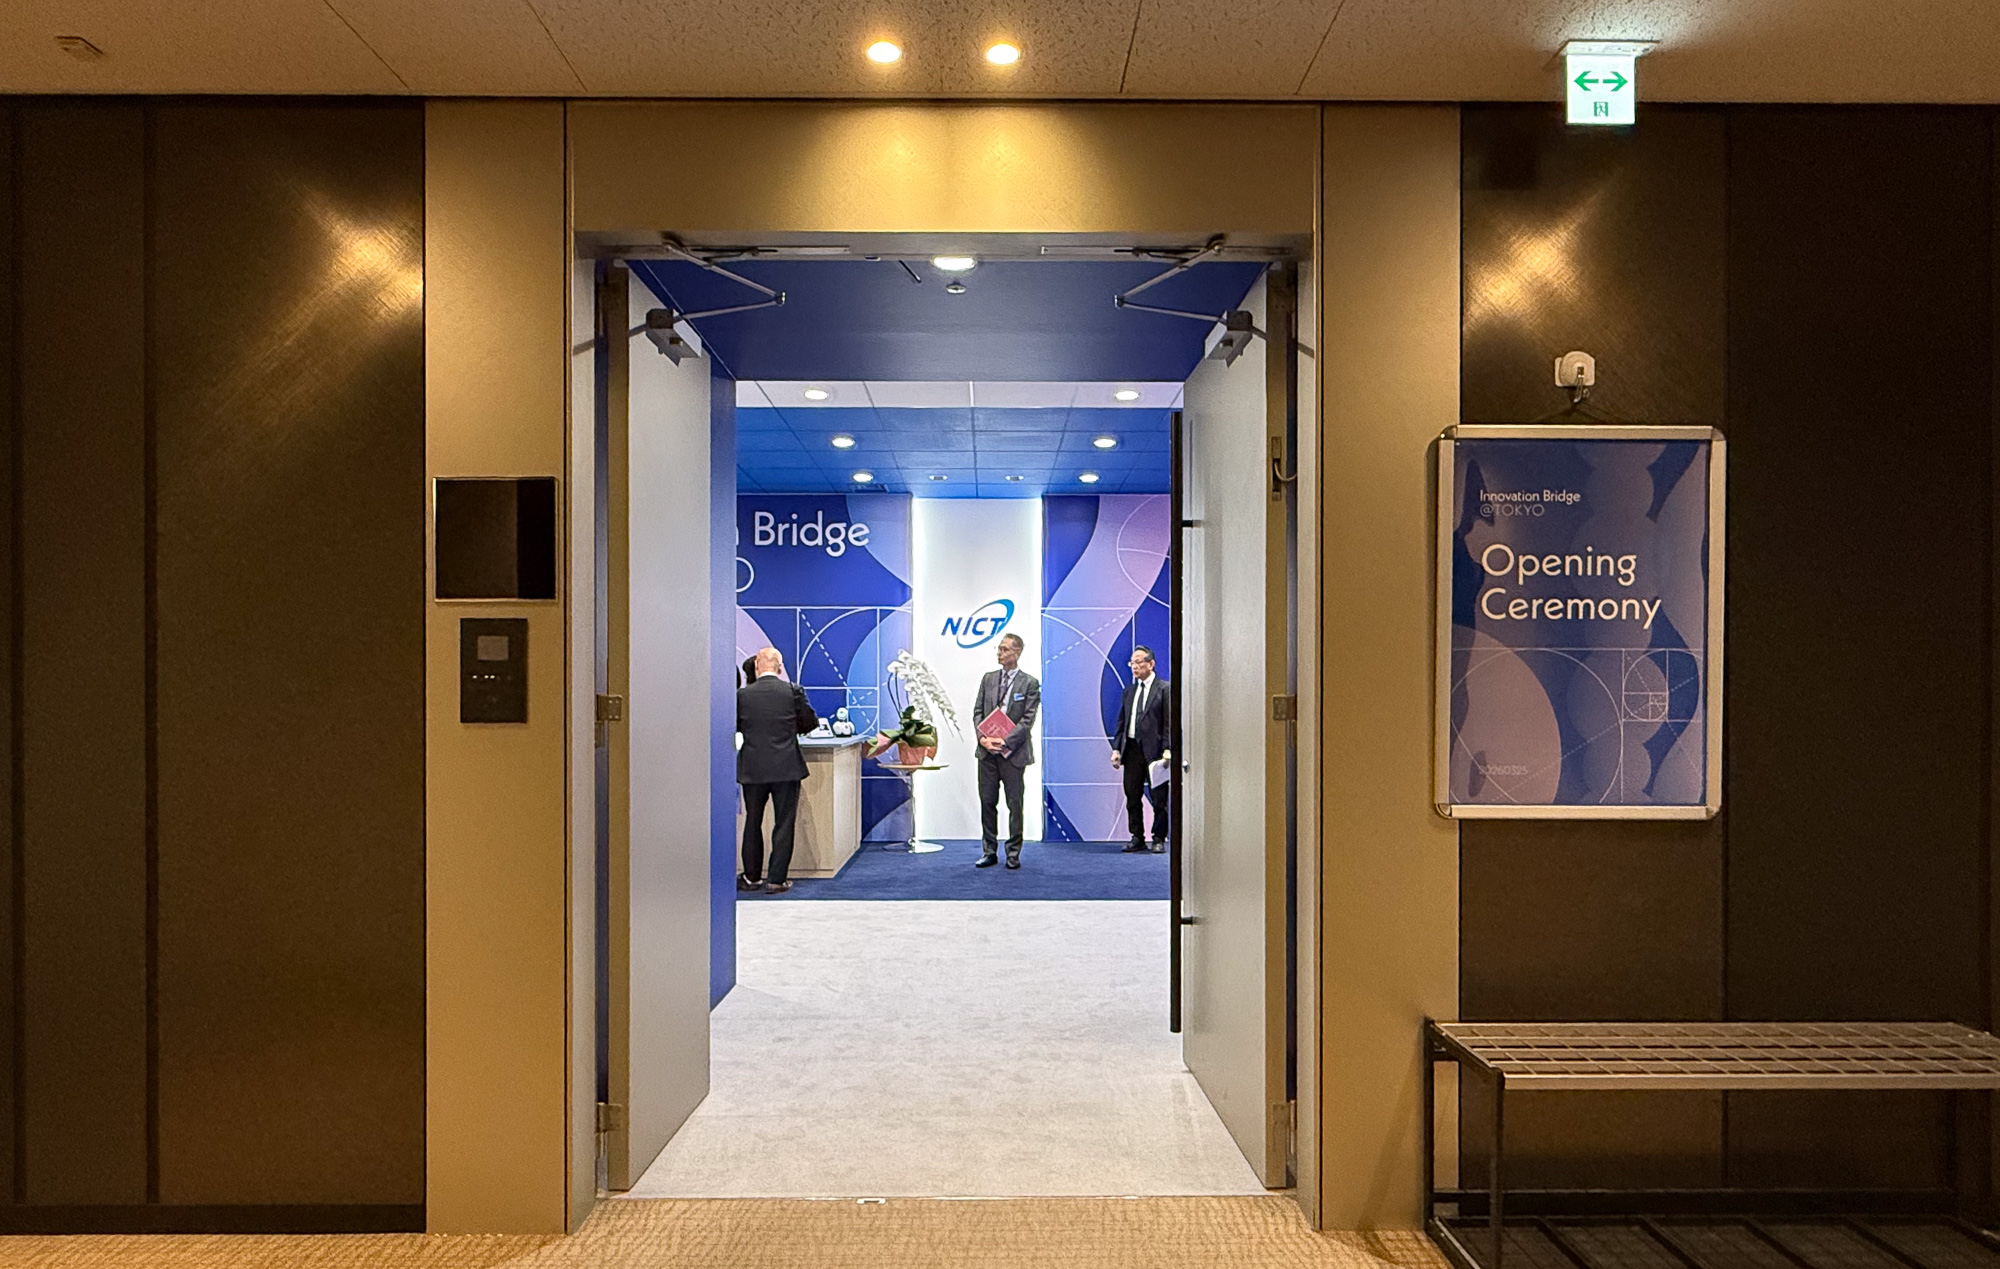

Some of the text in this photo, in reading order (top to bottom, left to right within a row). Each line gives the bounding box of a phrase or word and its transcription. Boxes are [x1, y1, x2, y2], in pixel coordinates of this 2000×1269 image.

[1480, 489, 1581, 505] Innovation Bridge
[1480, 503, 1545, 517] @TOKYO
[754, 510, 870, 557] Bridge
[1481, 543, 1637, 586] Opening
[1481, 587, 1661, 629] Ceremony
[941, 616, 1007, 636] NICT
